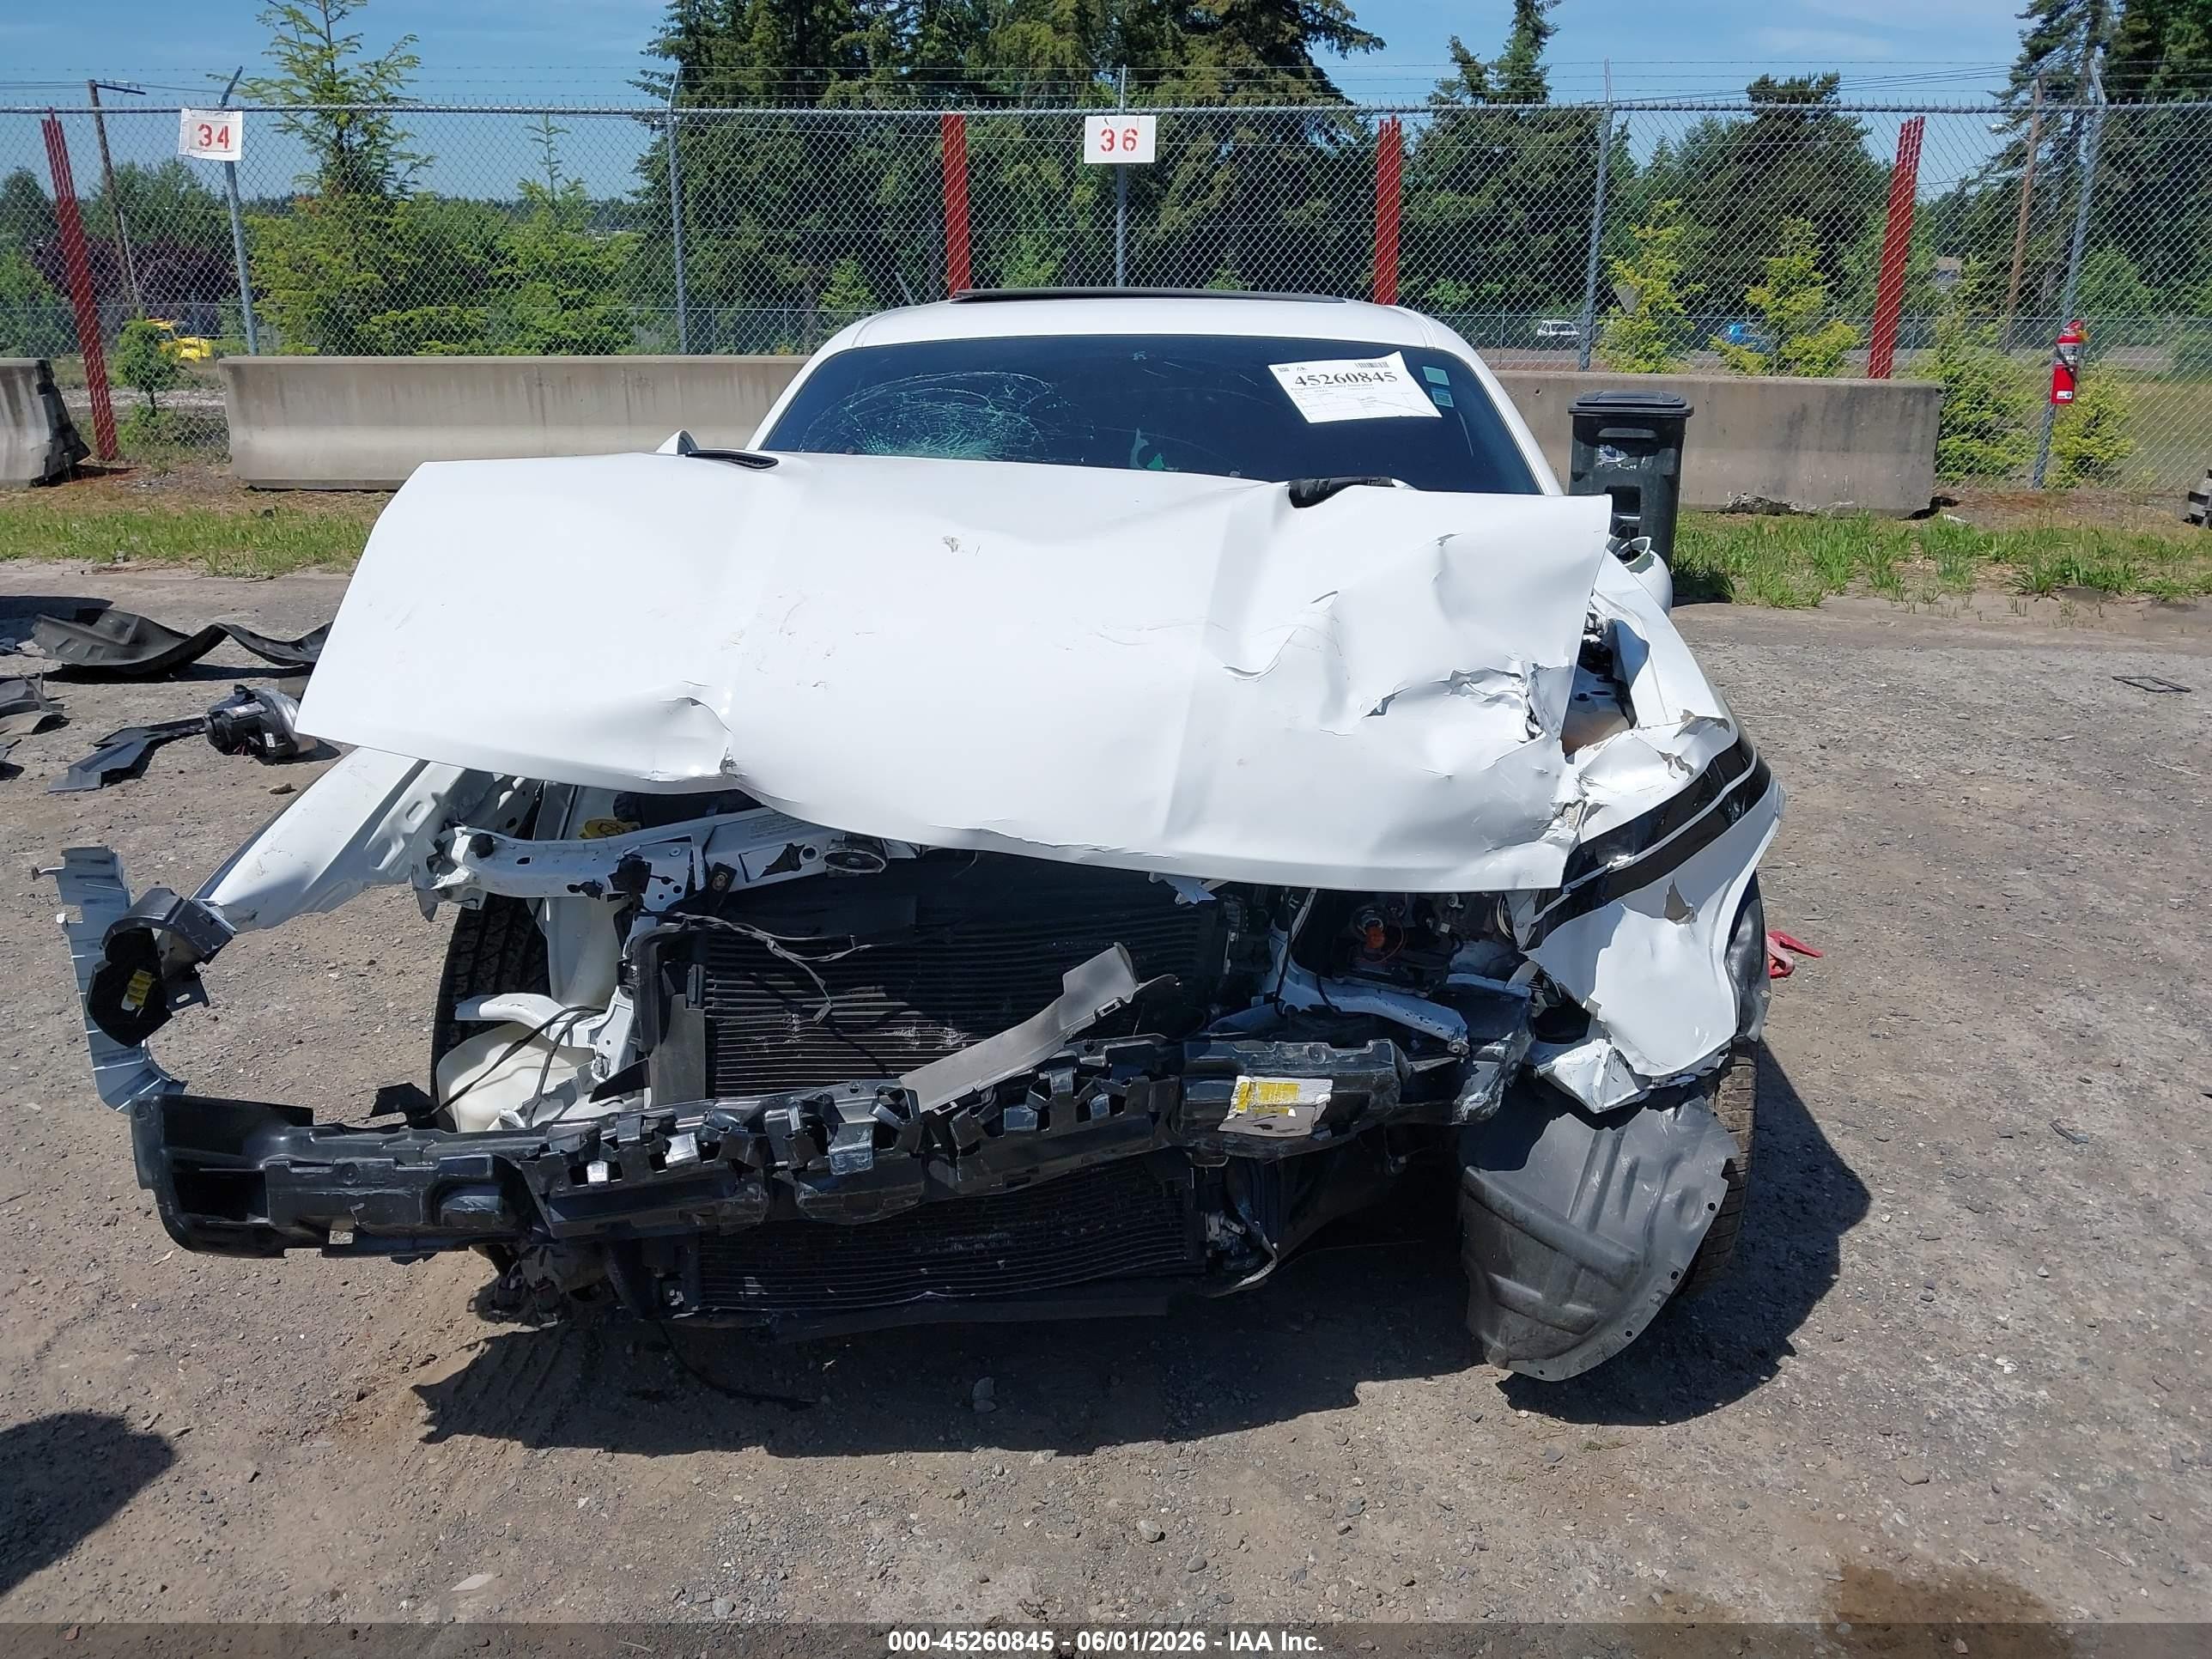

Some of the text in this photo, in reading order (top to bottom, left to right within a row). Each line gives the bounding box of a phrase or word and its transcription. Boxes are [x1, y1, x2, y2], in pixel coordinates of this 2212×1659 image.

[198, 124, 229, 149] 34
[1100, 128, 1138, 152] 36
[1294, 371, 1398, 386] 45260845
